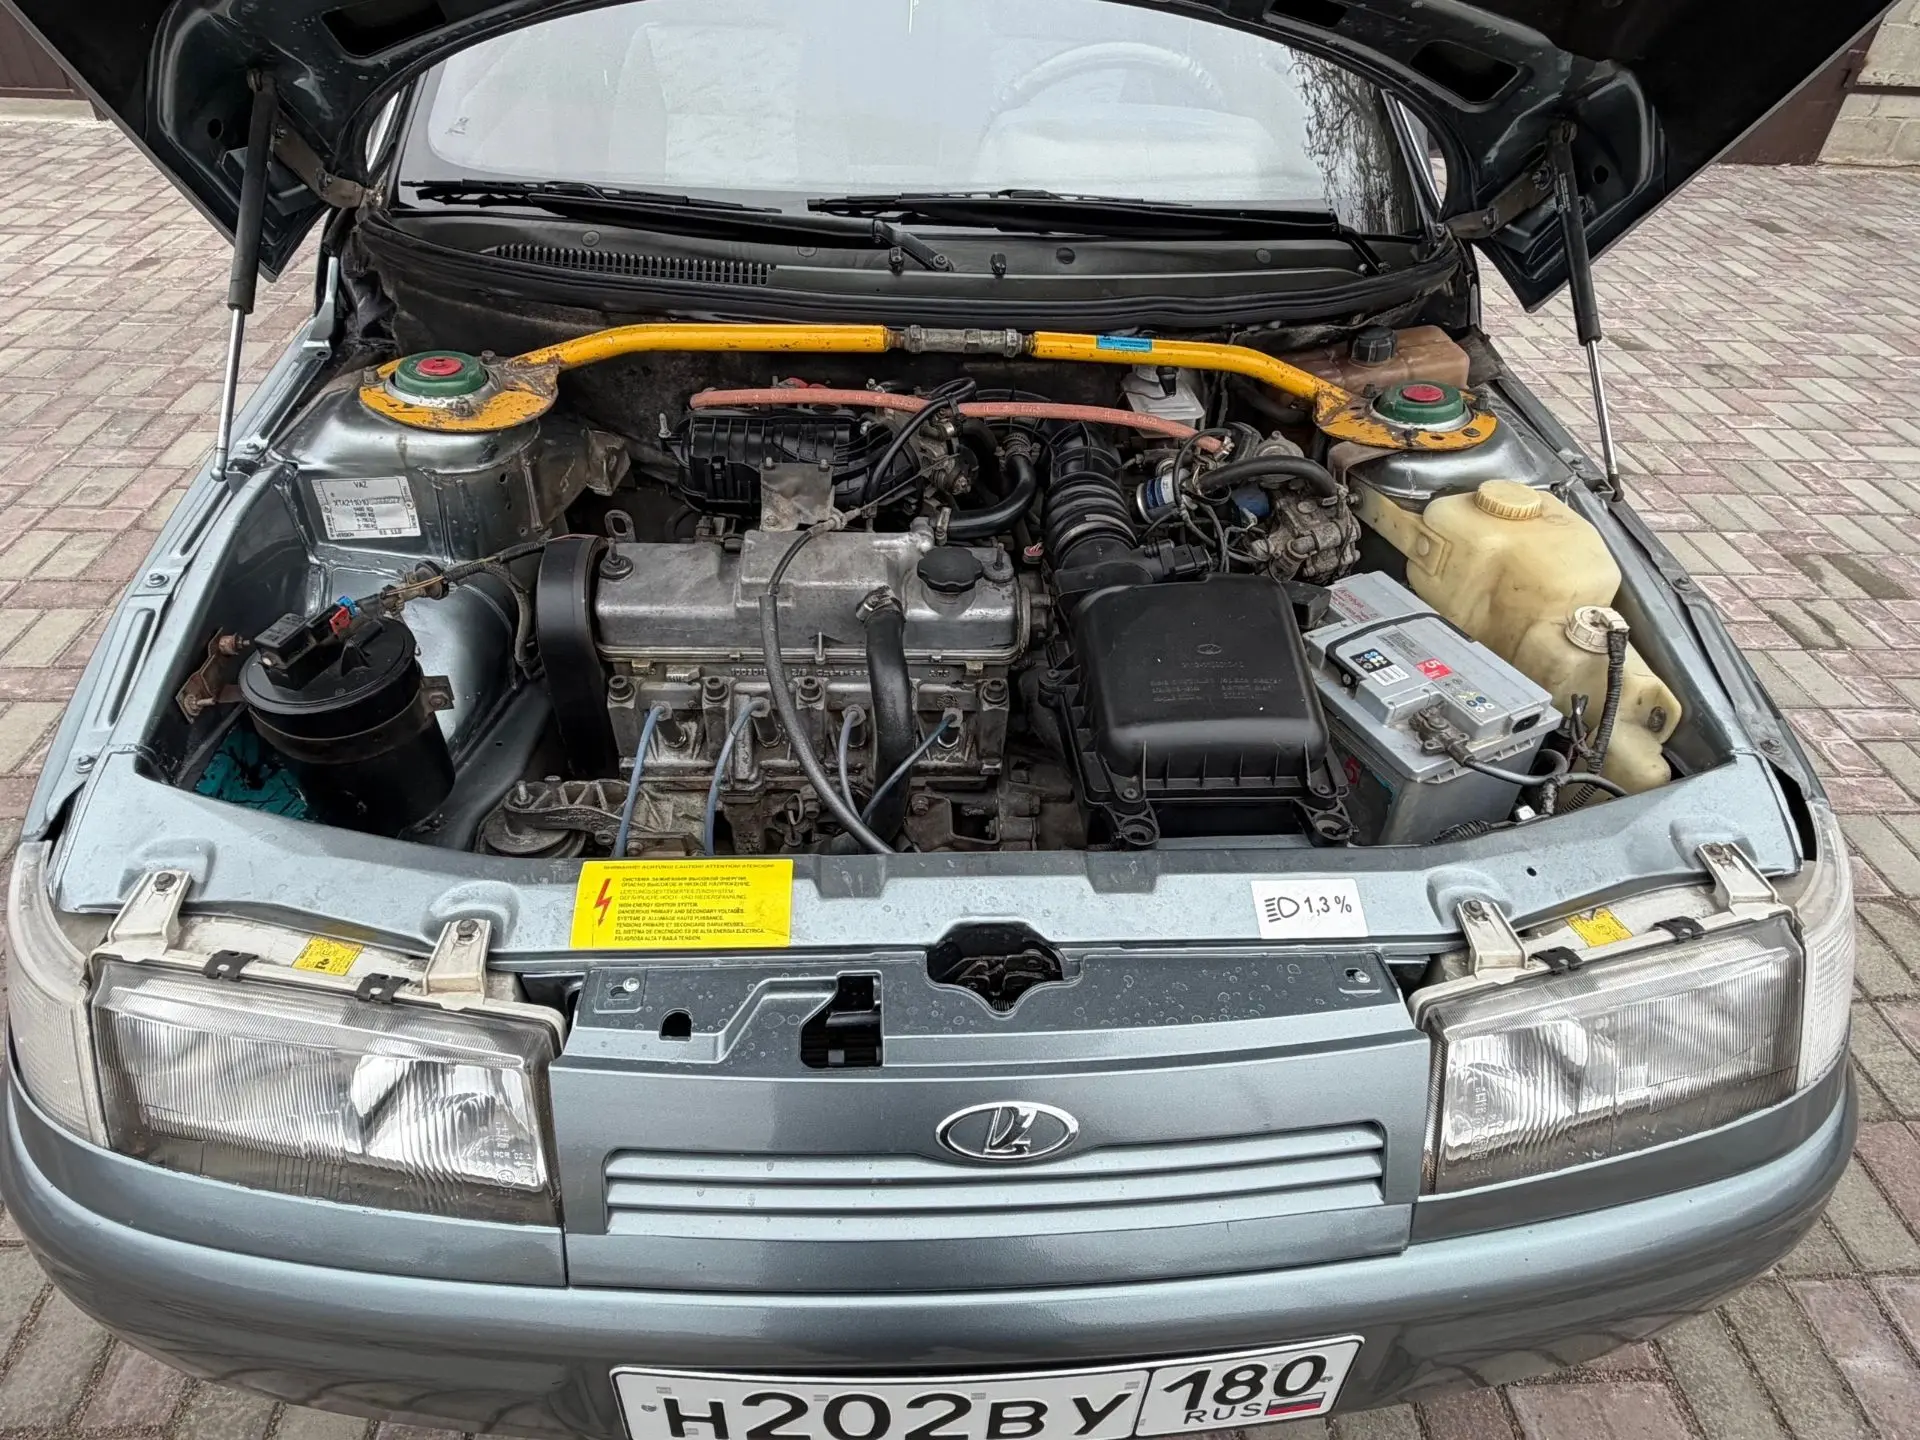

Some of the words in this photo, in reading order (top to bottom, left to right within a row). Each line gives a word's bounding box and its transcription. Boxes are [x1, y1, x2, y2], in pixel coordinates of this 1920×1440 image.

[353, 481, 368, 489] VAZ
[1163, 1354, 1327, 1411] 180
[1183, 1402, 1263, 1425] RUS
